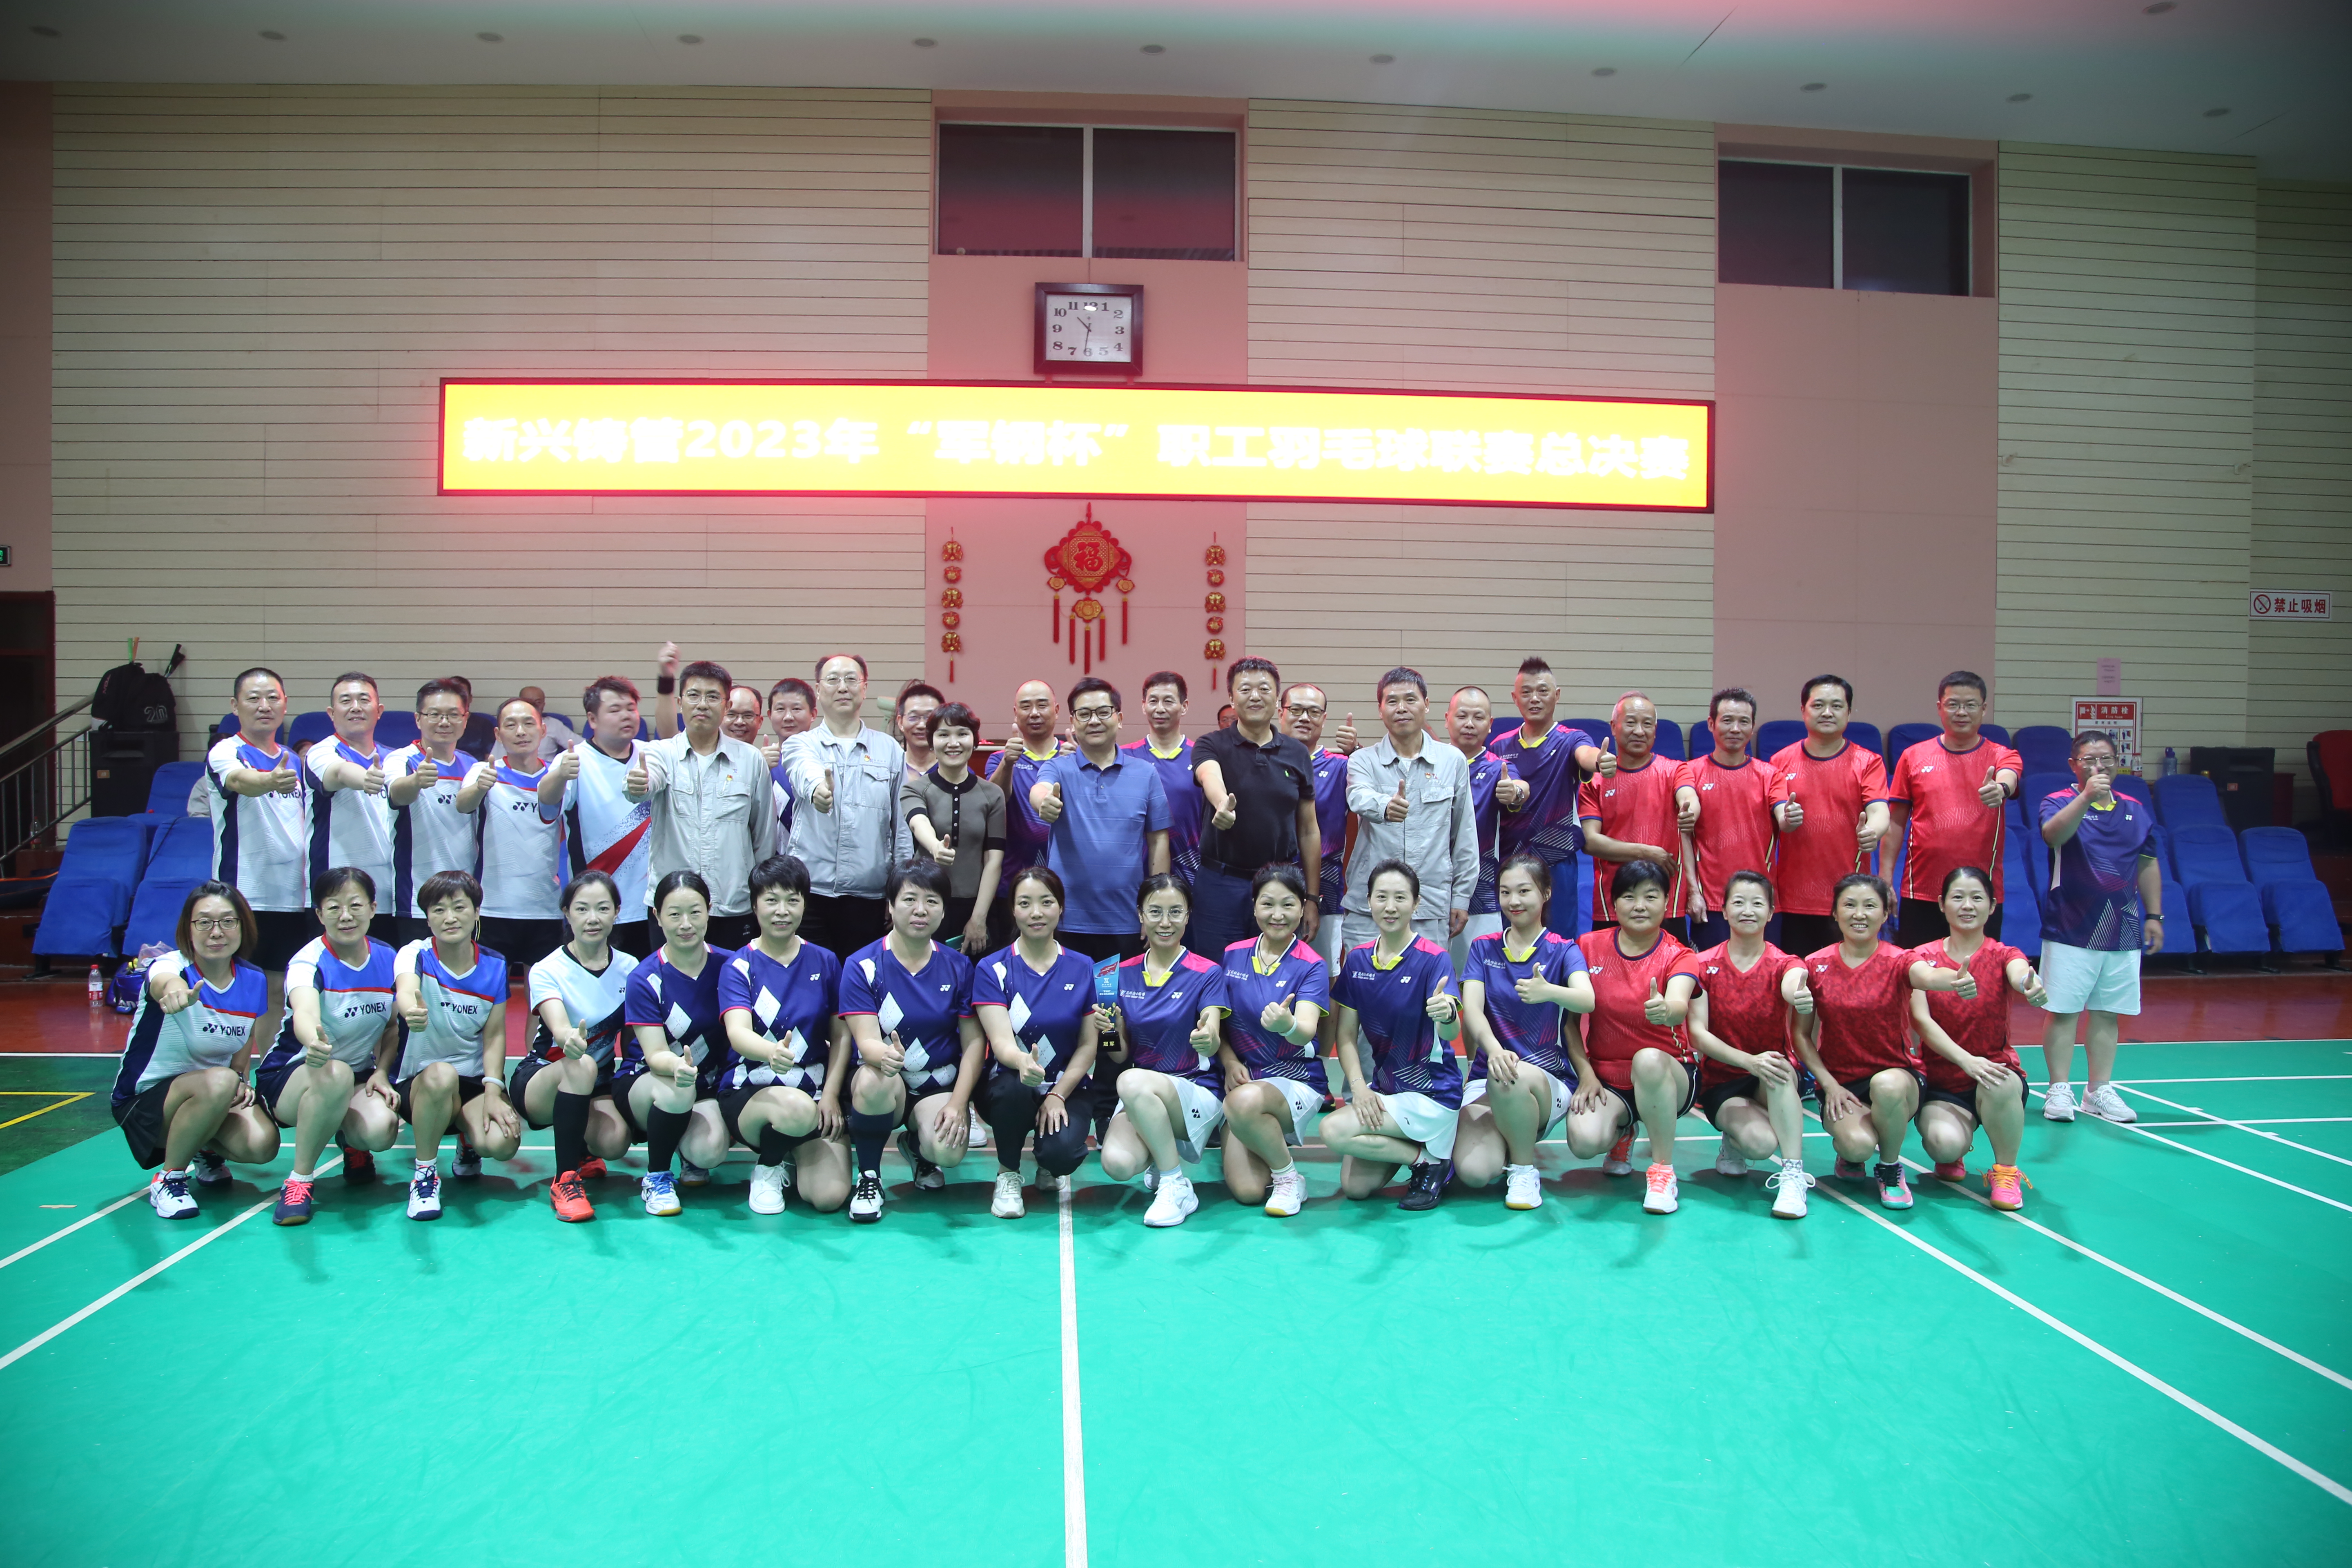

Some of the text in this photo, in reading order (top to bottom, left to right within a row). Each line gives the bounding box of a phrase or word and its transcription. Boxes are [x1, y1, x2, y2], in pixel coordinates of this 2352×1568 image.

[1068, 302, 1079, 310] 11
[1101, 302, 1109, 311] 1
[1054, 307, 1067, 317] 10
[1114, 310, 1123, 319] 2
[1052, 324, 1062, 333] 9
[1115, 326, 1125, 334] 3
[1053, 341, 1063, 350] 8
[1114, 343, 1123, 352] 4
[1067, 346, 1077, 356] 7
[1083, 348, 1093, 357] 6
[1099, 347, 1109, 356] 5
[1073, 541, 1104, 572] 福
[2274, 597, 2326, 614] 禁止吸烟
[2100, 706, 2129, 715] 消防栓
[360, 1001, 386, 1014] YONEX
[452, 1002, 477, 1015] YONEX
[220, 1025, 245, 1036] YONEX
